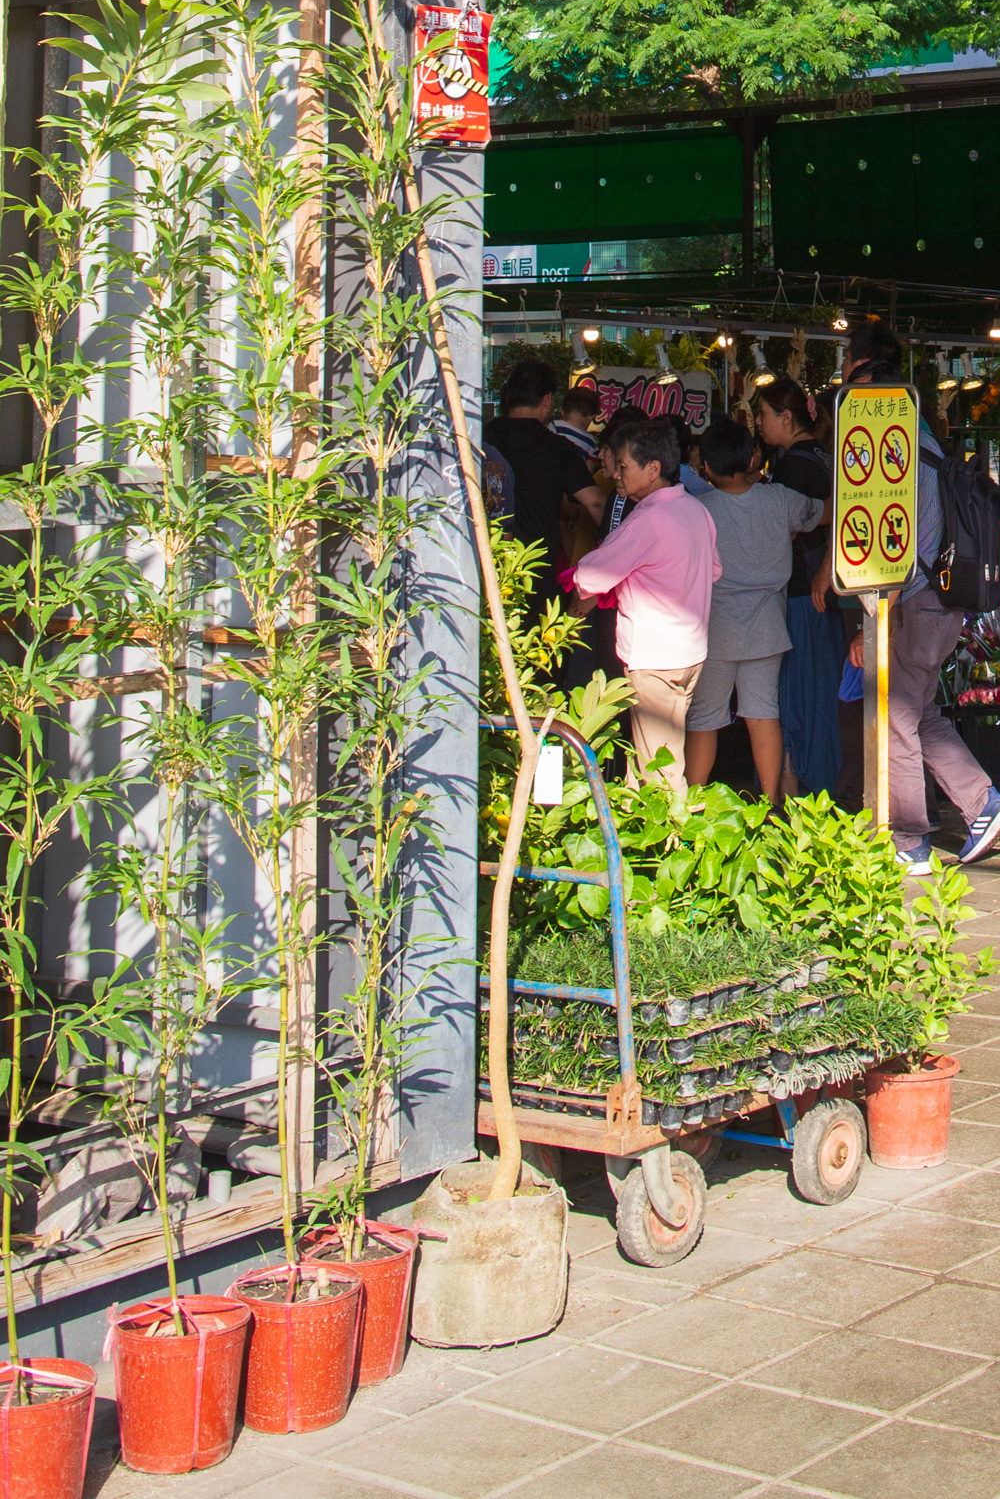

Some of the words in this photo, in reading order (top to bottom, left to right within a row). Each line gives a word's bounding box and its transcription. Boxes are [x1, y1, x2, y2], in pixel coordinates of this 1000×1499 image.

[839, 91, 870, 110] 1423
[577, 113, 607, 131] 1421
[502, 257, 533, 279] 郵局
[541, 267, 571, 283] POST
[847, 397, 909, 419] 行人徒步區
